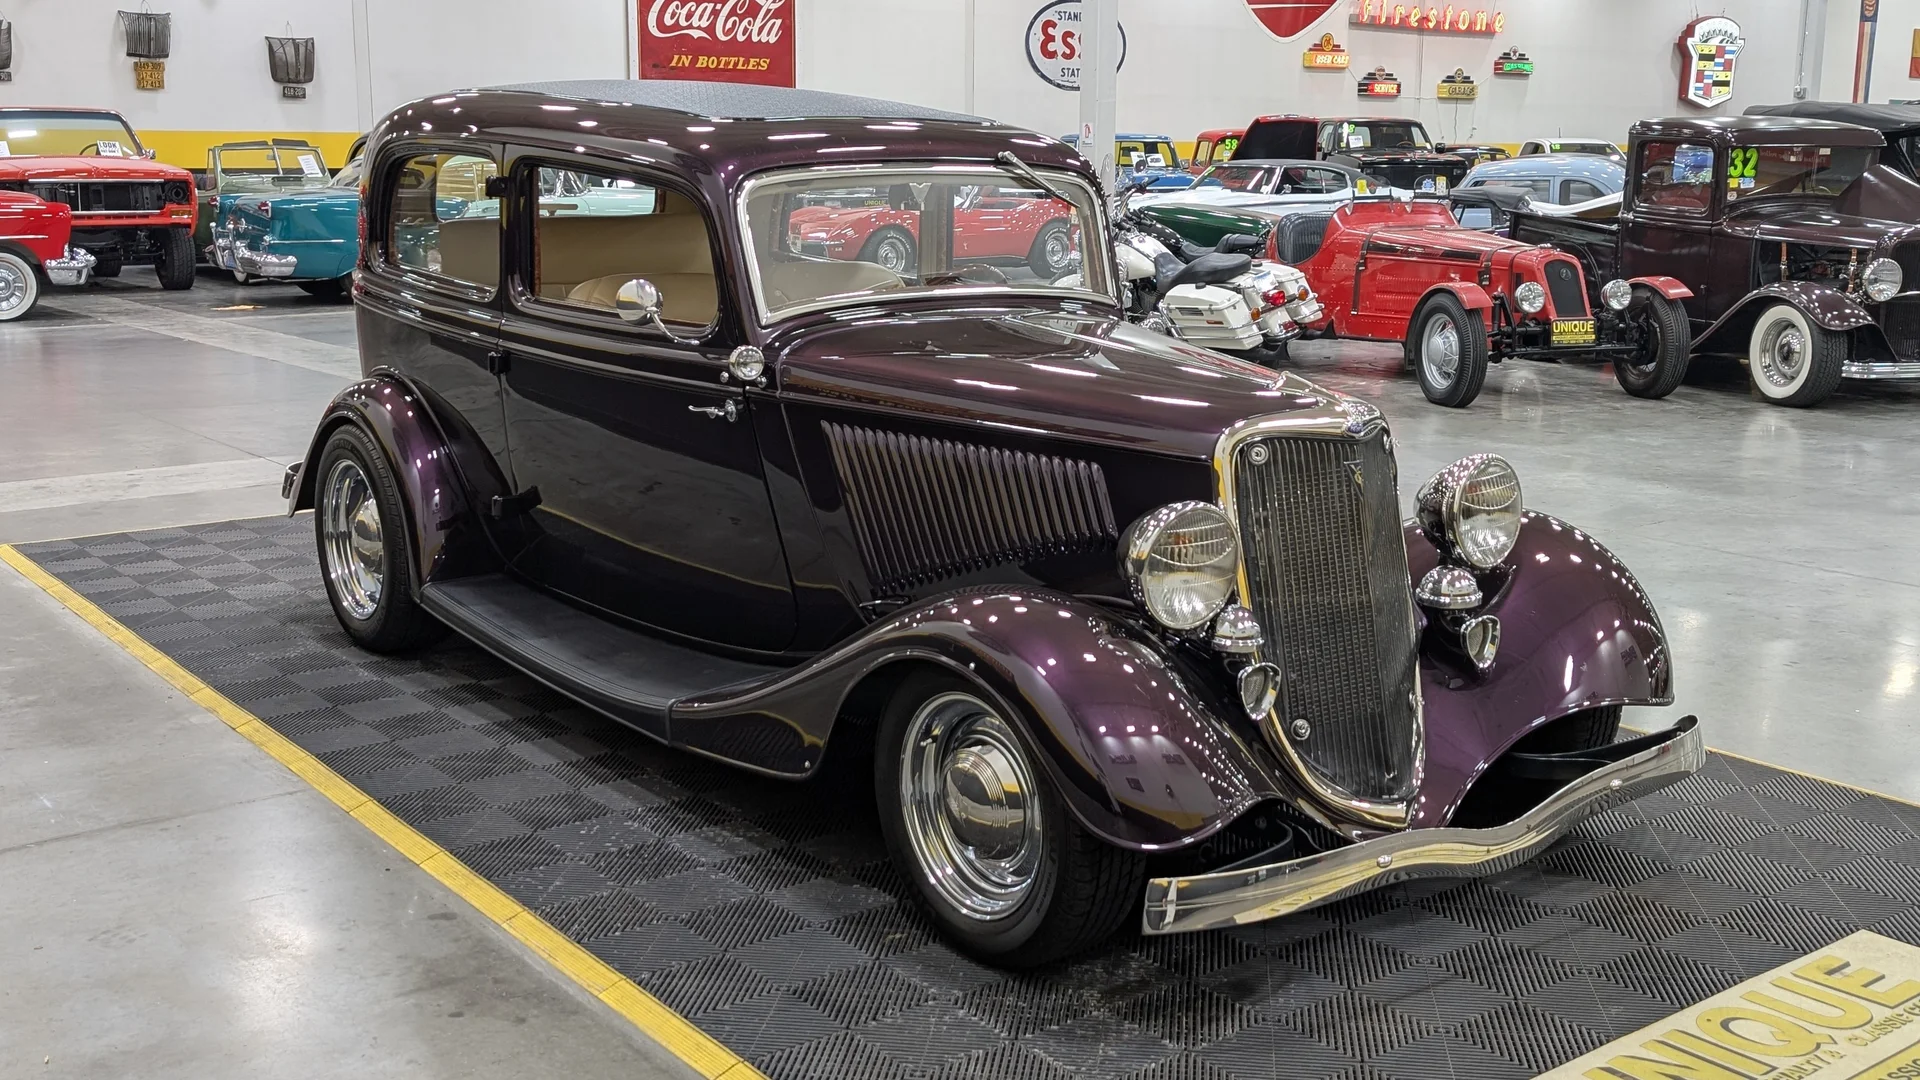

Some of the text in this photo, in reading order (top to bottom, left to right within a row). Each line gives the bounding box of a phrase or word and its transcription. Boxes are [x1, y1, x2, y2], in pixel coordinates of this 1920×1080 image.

[648, 0, 783, 44] Coca-Cola
[1054, 10, 1081, 22] "STAN
[1358, 0, 1505, 33] Firestone
[1040, 19, 1081, 60] Es
[669, 55, 770, 70] IN BOTTLES
[1503, 62, 1533, 72] GASOLINE
[1060, 67, 1081, 78] STAT
[1373, 83, 1398, 93] SERVICE
[99, 141, 118, 149] LOOK
[1225, 138, 1239, 150] 58
[1729, 148, 1759, 178] 32
[1553, 320, 1595, 333] UNIQUE
[1582, 955, 1920, 1080] NIQUE
[1845, 1012, 1914, 1047] CLASSIC
